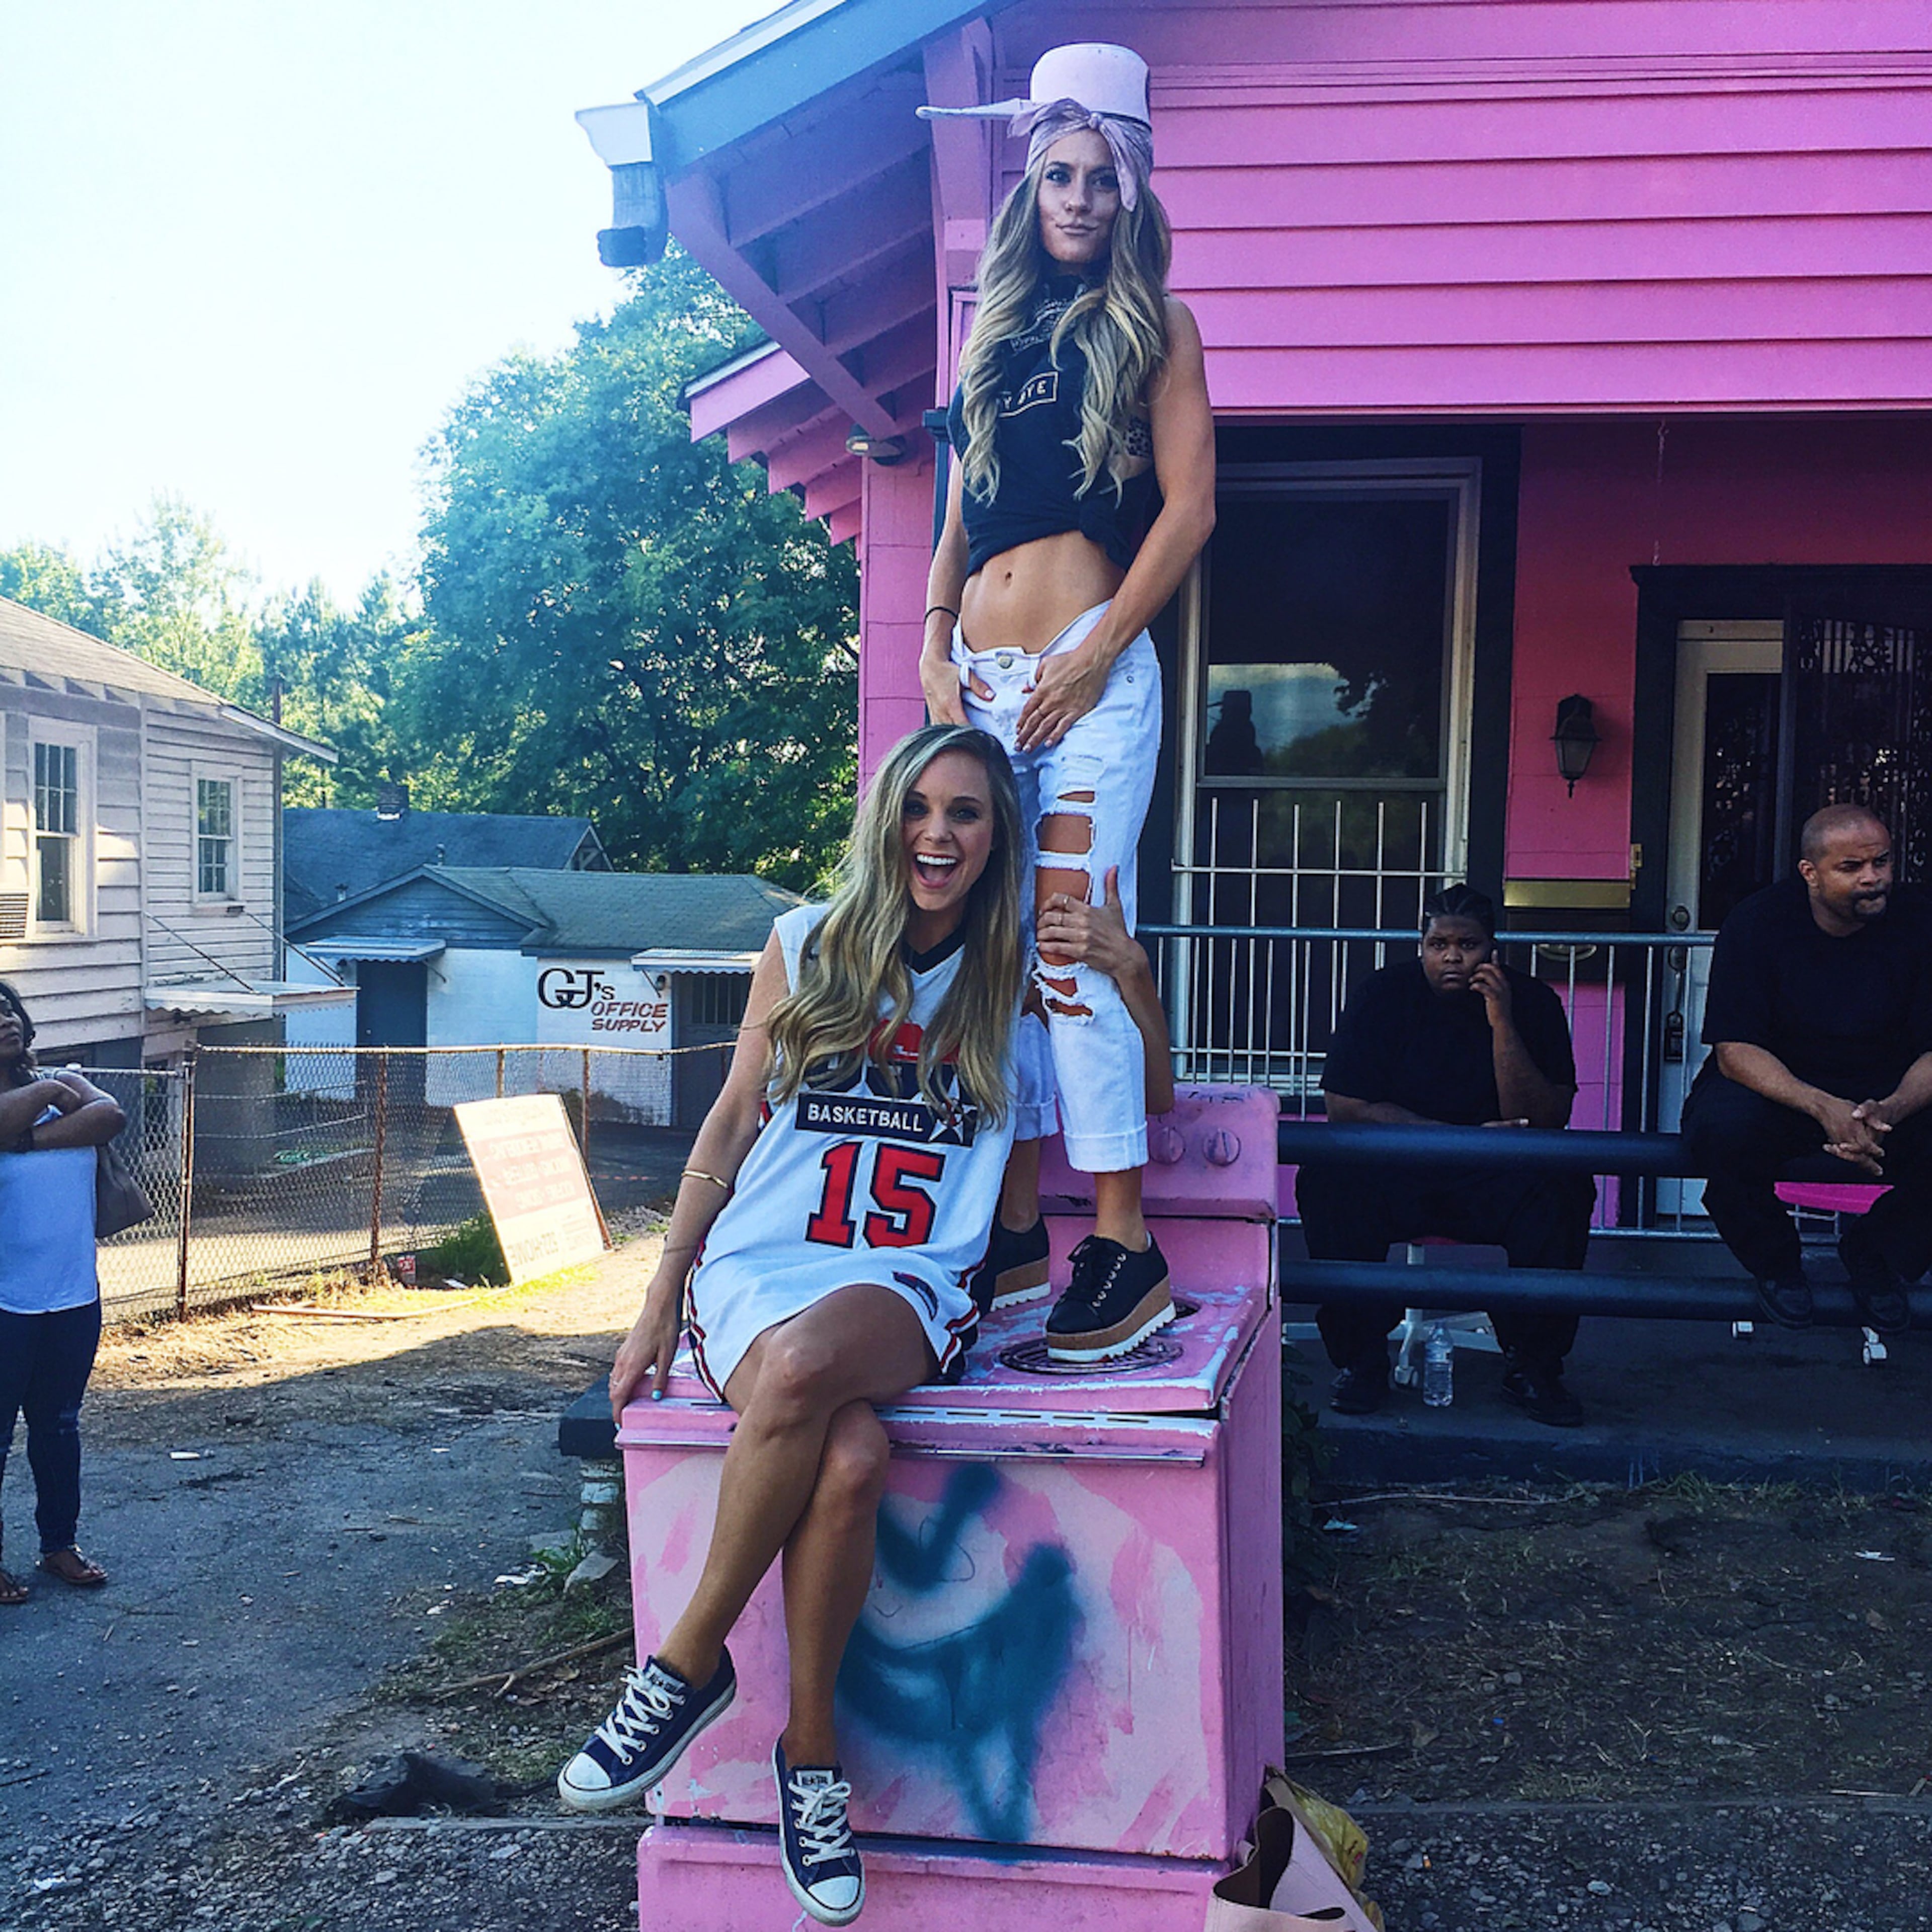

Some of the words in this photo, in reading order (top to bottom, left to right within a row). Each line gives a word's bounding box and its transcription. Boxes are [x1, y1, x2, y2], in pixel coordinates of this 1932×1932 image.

[591, 1001, 669, 1018] OFFICE
[592, 1018, 666, 1032] SUPPLY
[807, 1103, 924, 1133] BASKETBALL
[806, 1141, 946, 1249] 15
